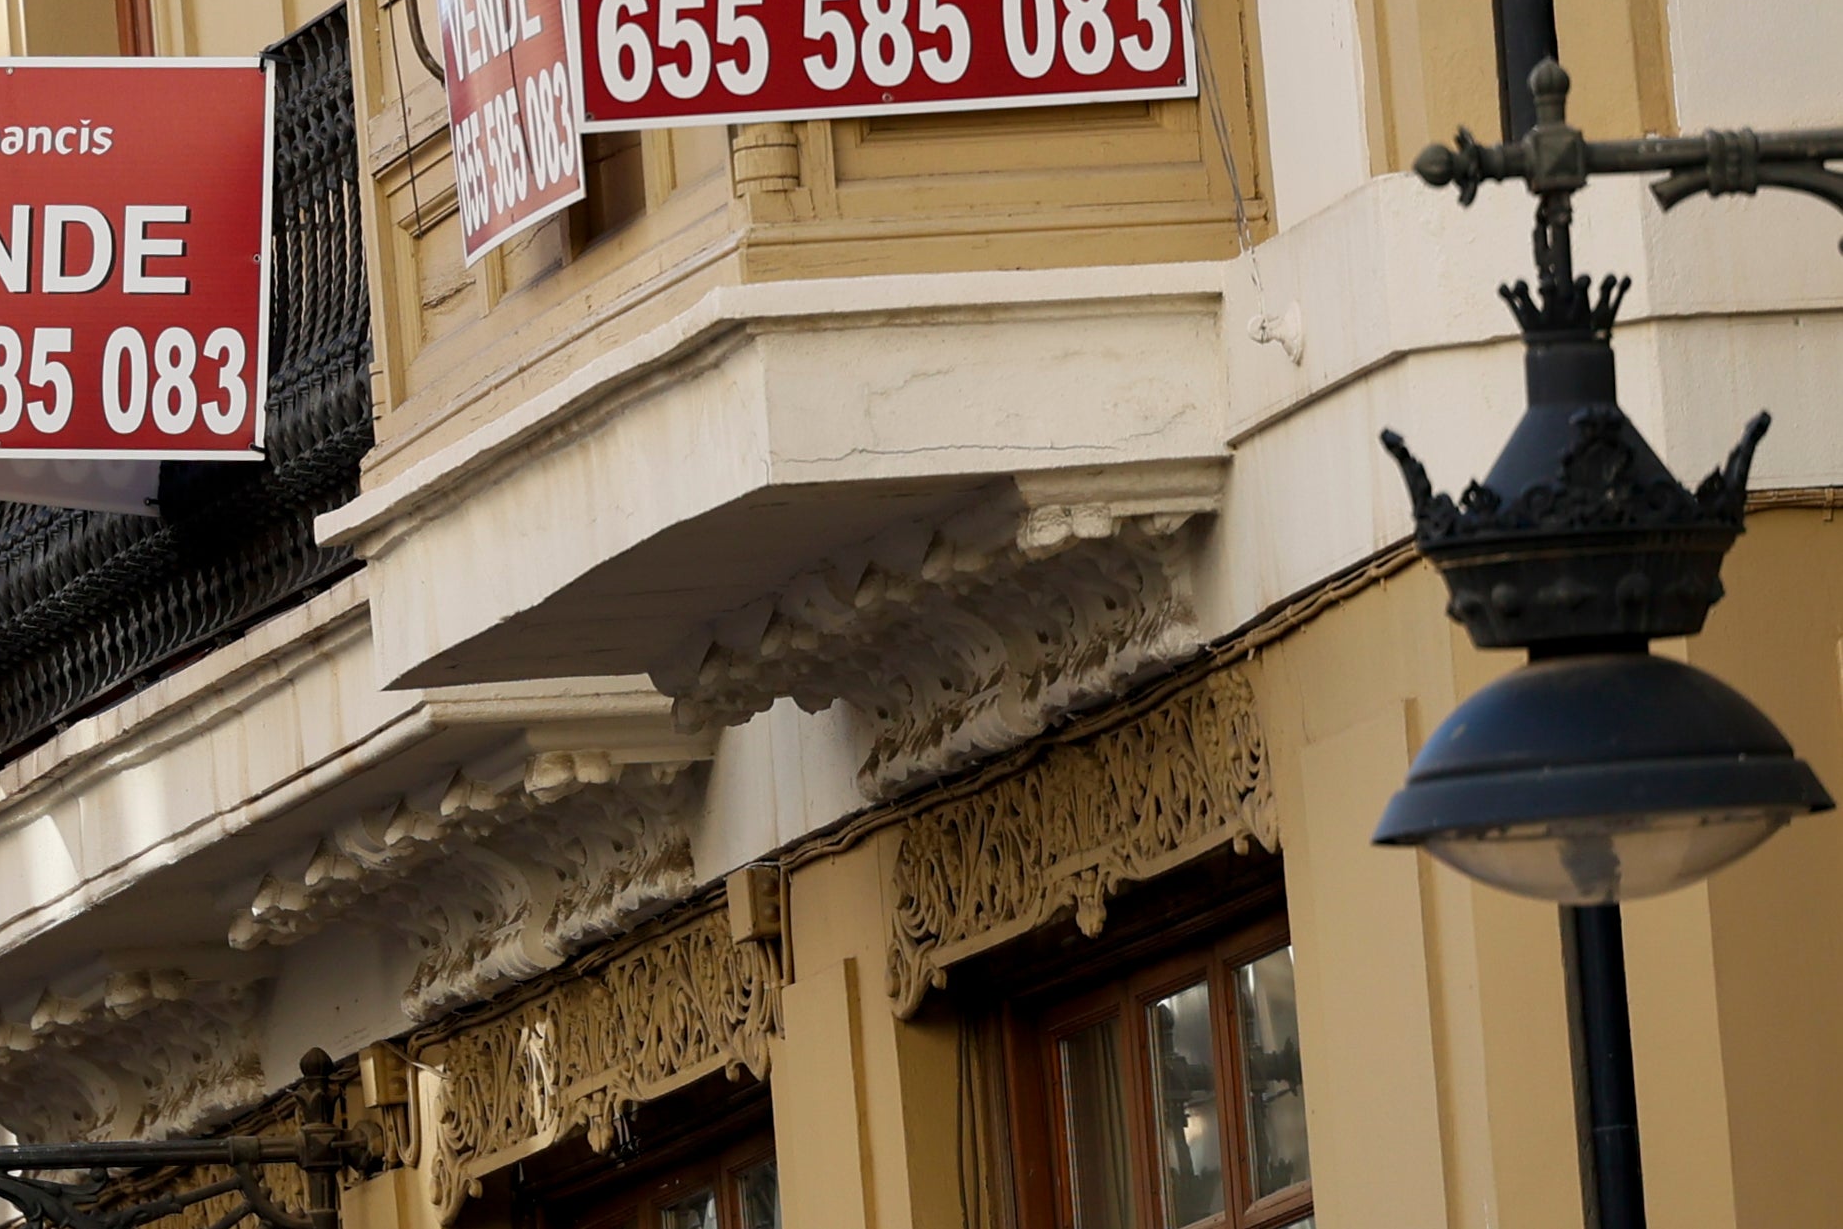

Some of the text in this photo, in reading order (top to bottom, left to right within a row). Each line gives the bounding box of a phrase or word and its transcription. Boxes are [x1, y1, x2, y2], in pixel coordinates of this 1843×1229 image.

[454, 60, 575, 238] 655 585 083
[100, 325, 248, 435] 083
